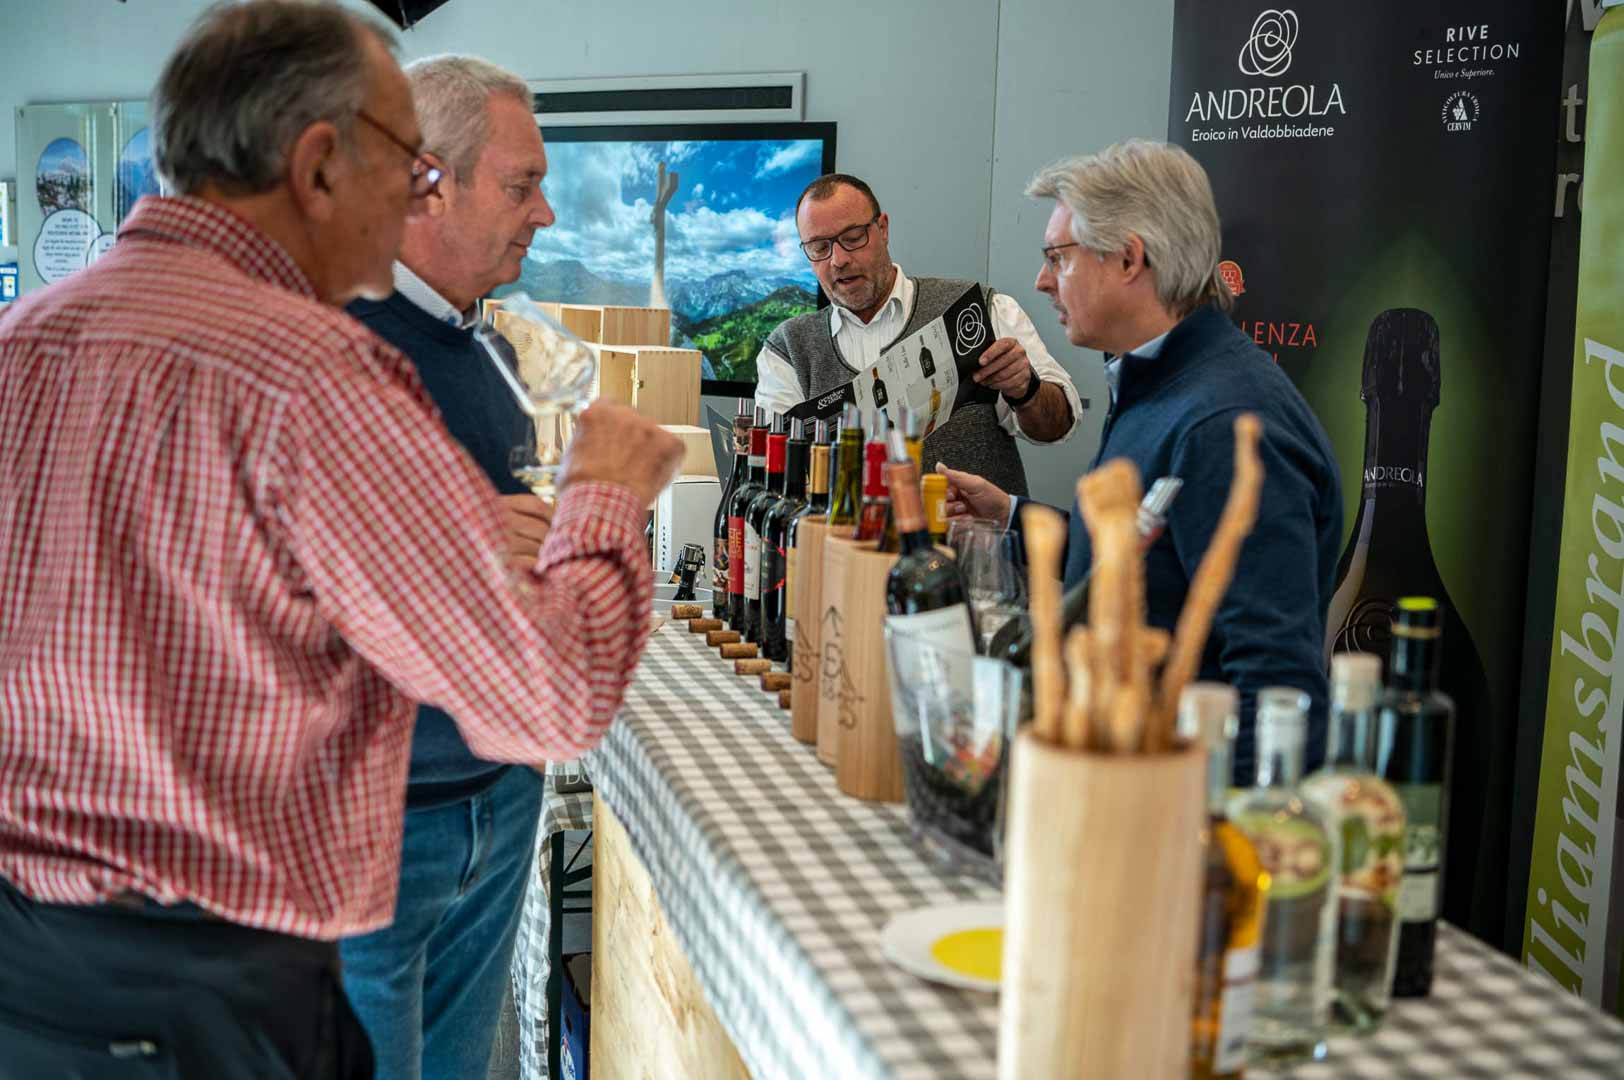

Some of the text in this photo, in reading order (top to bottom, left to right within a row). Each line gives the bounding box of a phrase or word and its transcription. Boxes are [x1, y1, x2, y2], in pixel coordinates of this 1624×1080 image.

[1446, 24, 1489, 43] RIVE
[1413, 43, 1520, 65] SELECTION
[1434, 69, 1454, 79] Unico
[1185, 84, 1347, 122] ANDREOLA
[1192, 123, 1335, 142] Eroico in Valdobbiadene
[1447, 121, 1471, 132] CERVIM
[1364, 466, 1424, 488] ANDREOLA
